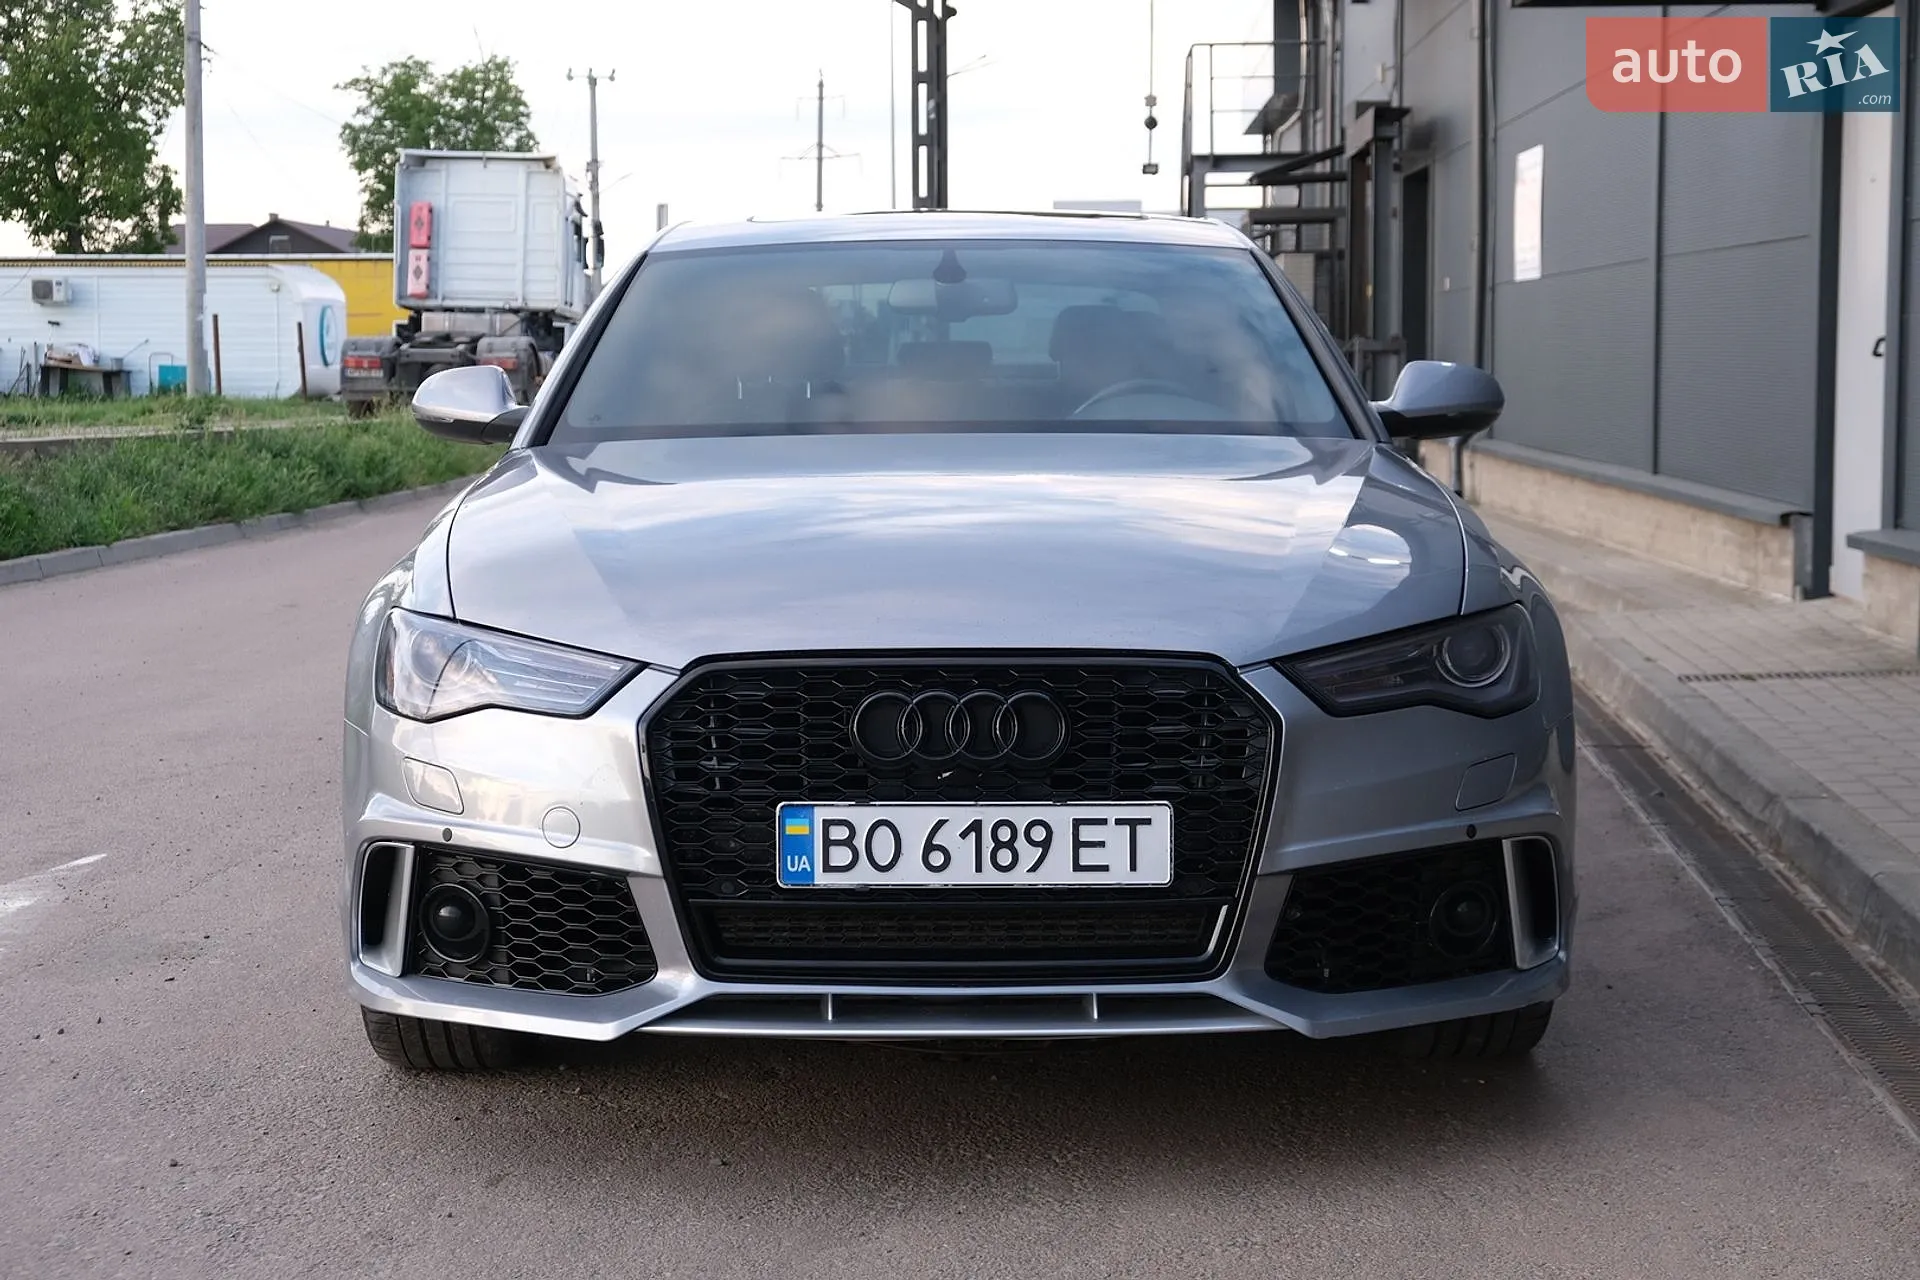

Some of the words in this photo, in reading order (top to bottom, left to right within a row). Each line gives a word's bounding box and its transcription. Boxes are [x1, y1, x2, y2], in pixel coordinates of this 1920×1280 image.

[821, 818, 901, 873] BO
[920, 818, 1054, 873] 6189
[1071, 817, 1152, 872] ET
[787, 856, 811, 872] UA
